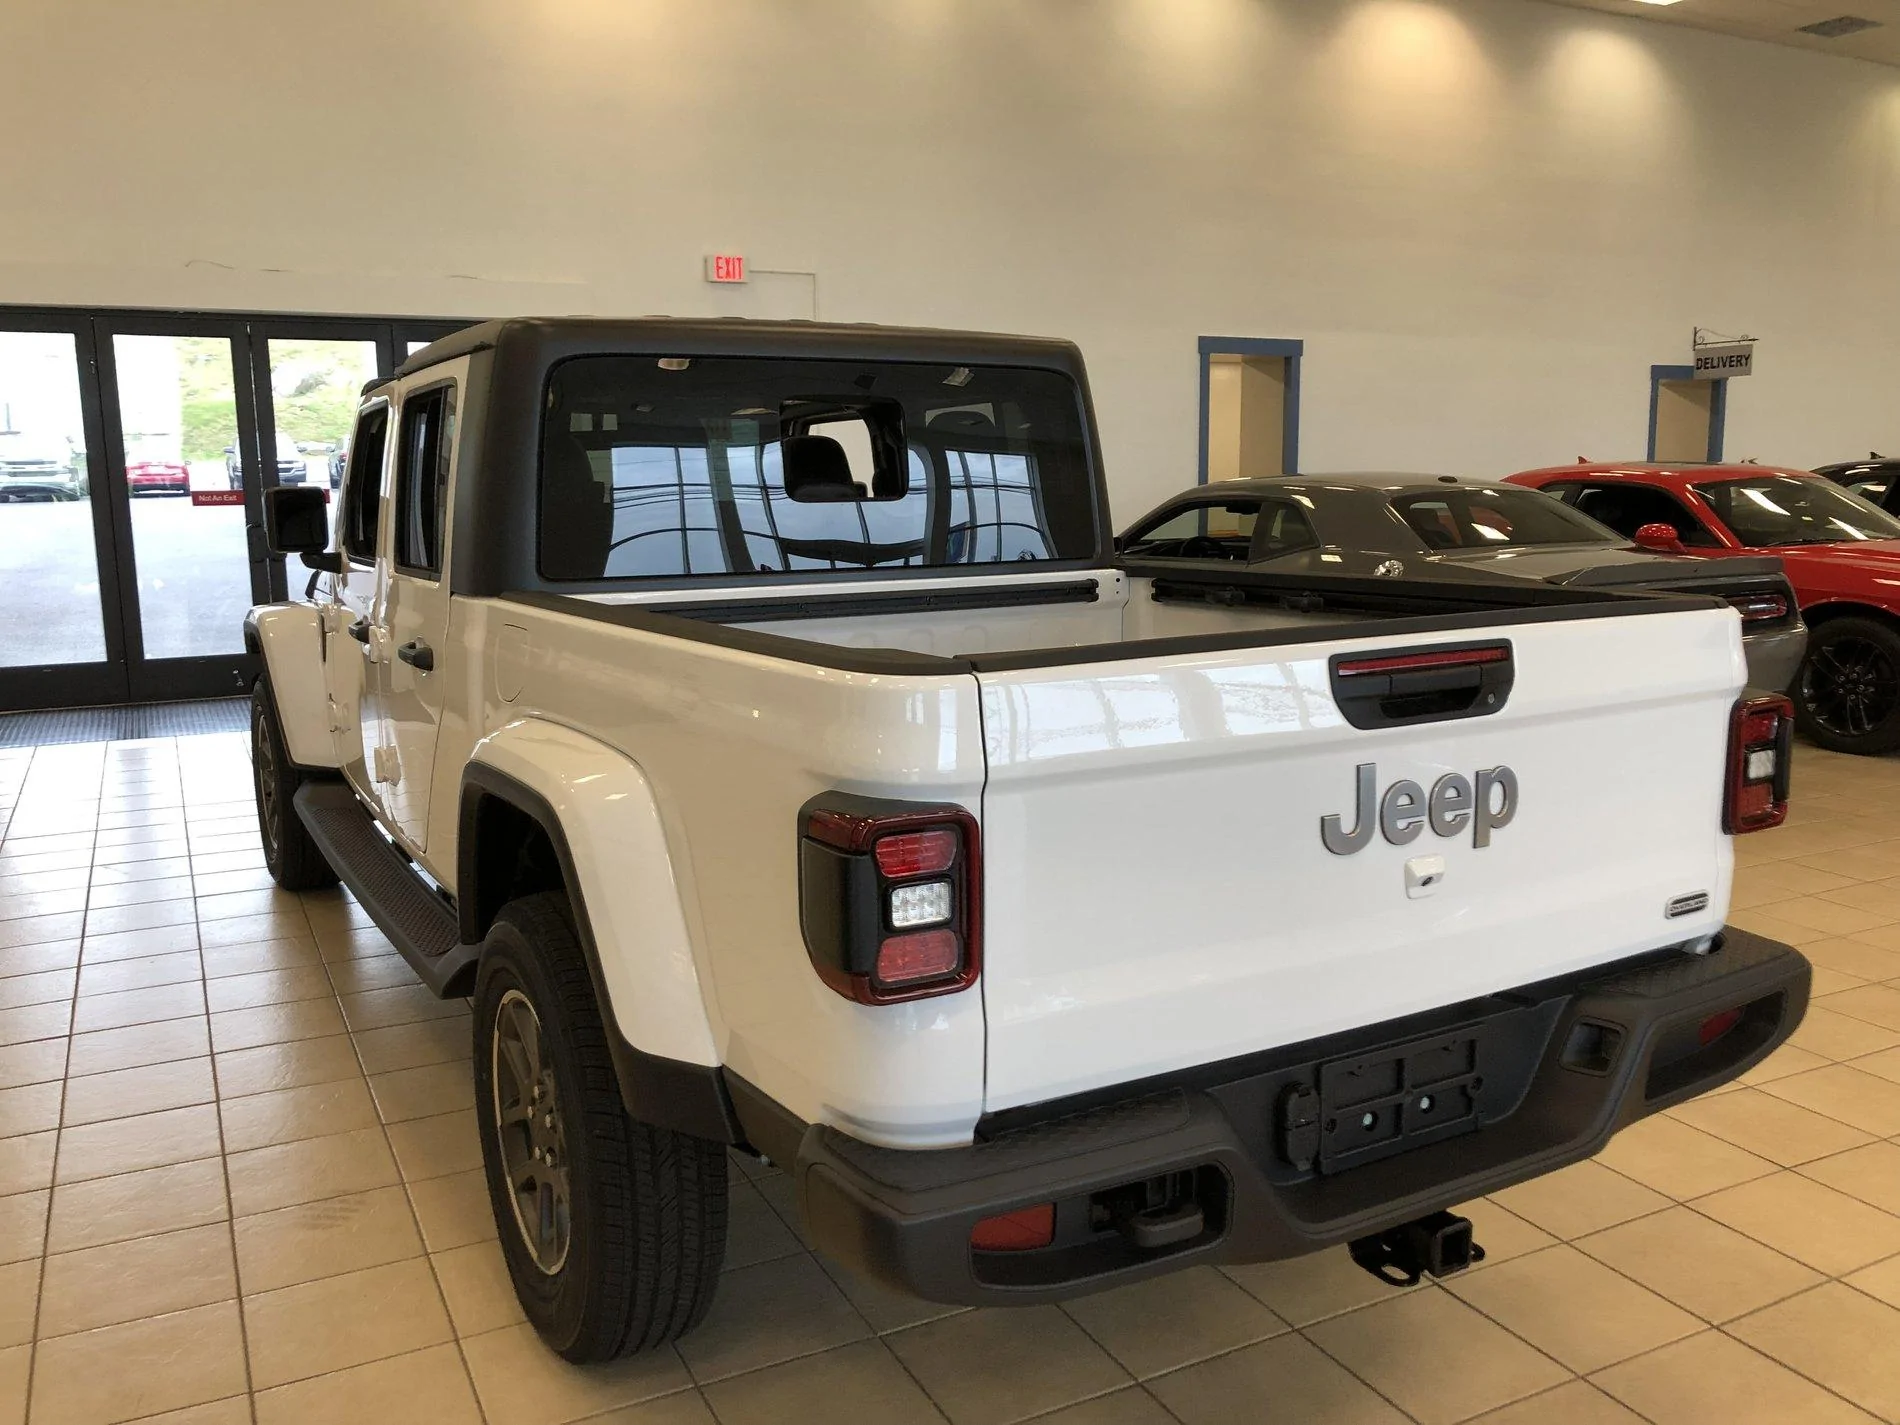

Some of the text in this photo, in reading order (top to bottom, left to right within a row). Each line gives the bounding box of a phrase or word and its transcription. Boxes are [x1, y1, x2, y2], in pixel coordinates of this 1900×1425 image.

[715, 256, 743, 280] EXIT
[1696, 354, 1751, 370] DELIVERY
[198, 494, 238, 502] Not An Exit
[1321, 763, 1519, 855] Jeep
